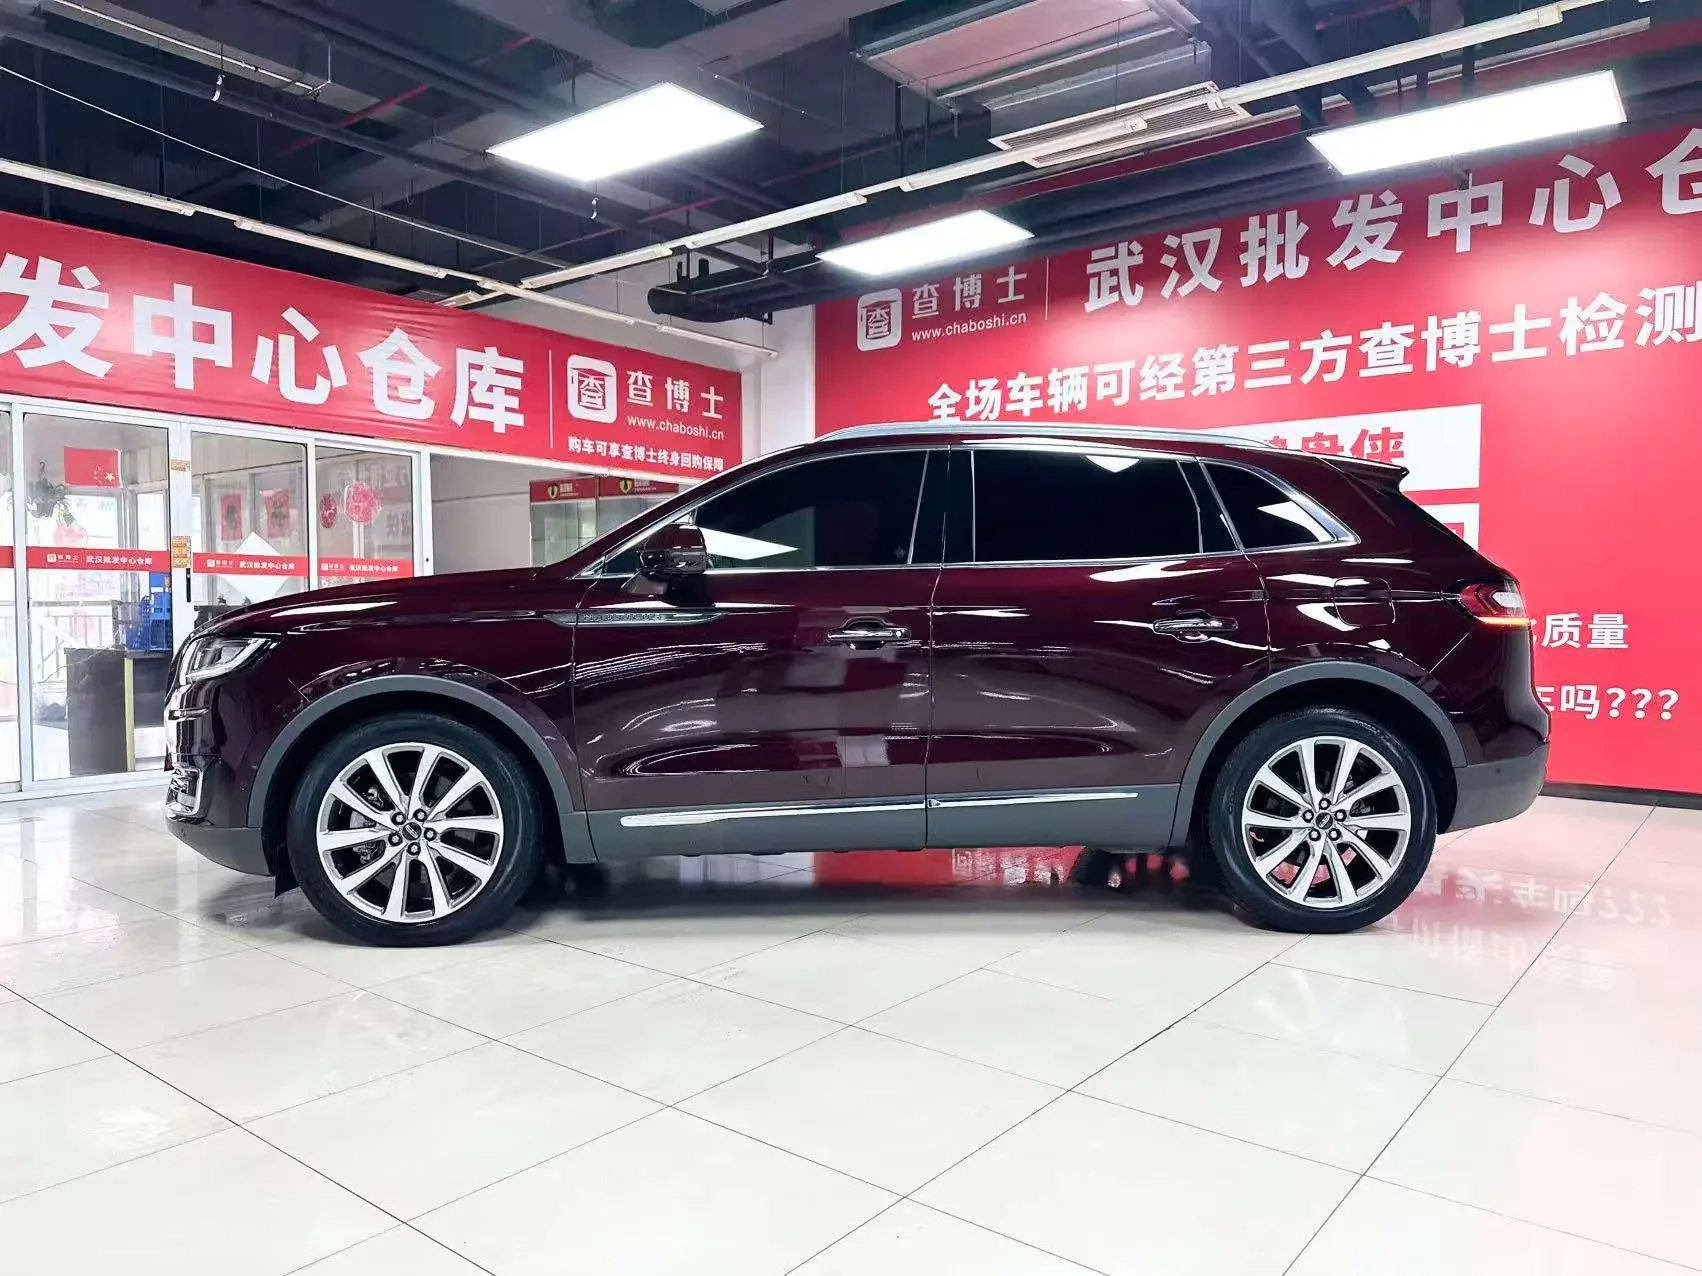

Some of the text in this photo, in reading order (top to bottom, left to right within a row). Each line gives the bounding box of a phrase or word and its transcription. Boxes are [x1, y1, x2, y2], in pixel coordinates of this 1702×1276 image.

[1084, 128, 1702, 313] 武汉批发中心仓
[911, 266, 1027, 319] 查博士
[0, 253, 525, 434] 发中心仓库
[911, 312, 1027, 341] www.chaboshi.cn
[928, 280, 1702, 424] 全场车辆可经第三方查博士检测
[626, 370, 724, 420] 查博士
[627, 415, 725, 441] www.chaboshi.cn
[568, 435, 725, 472] 购车可享查博士终身回购保障
[1530, 612, 1629, 649] 质量
